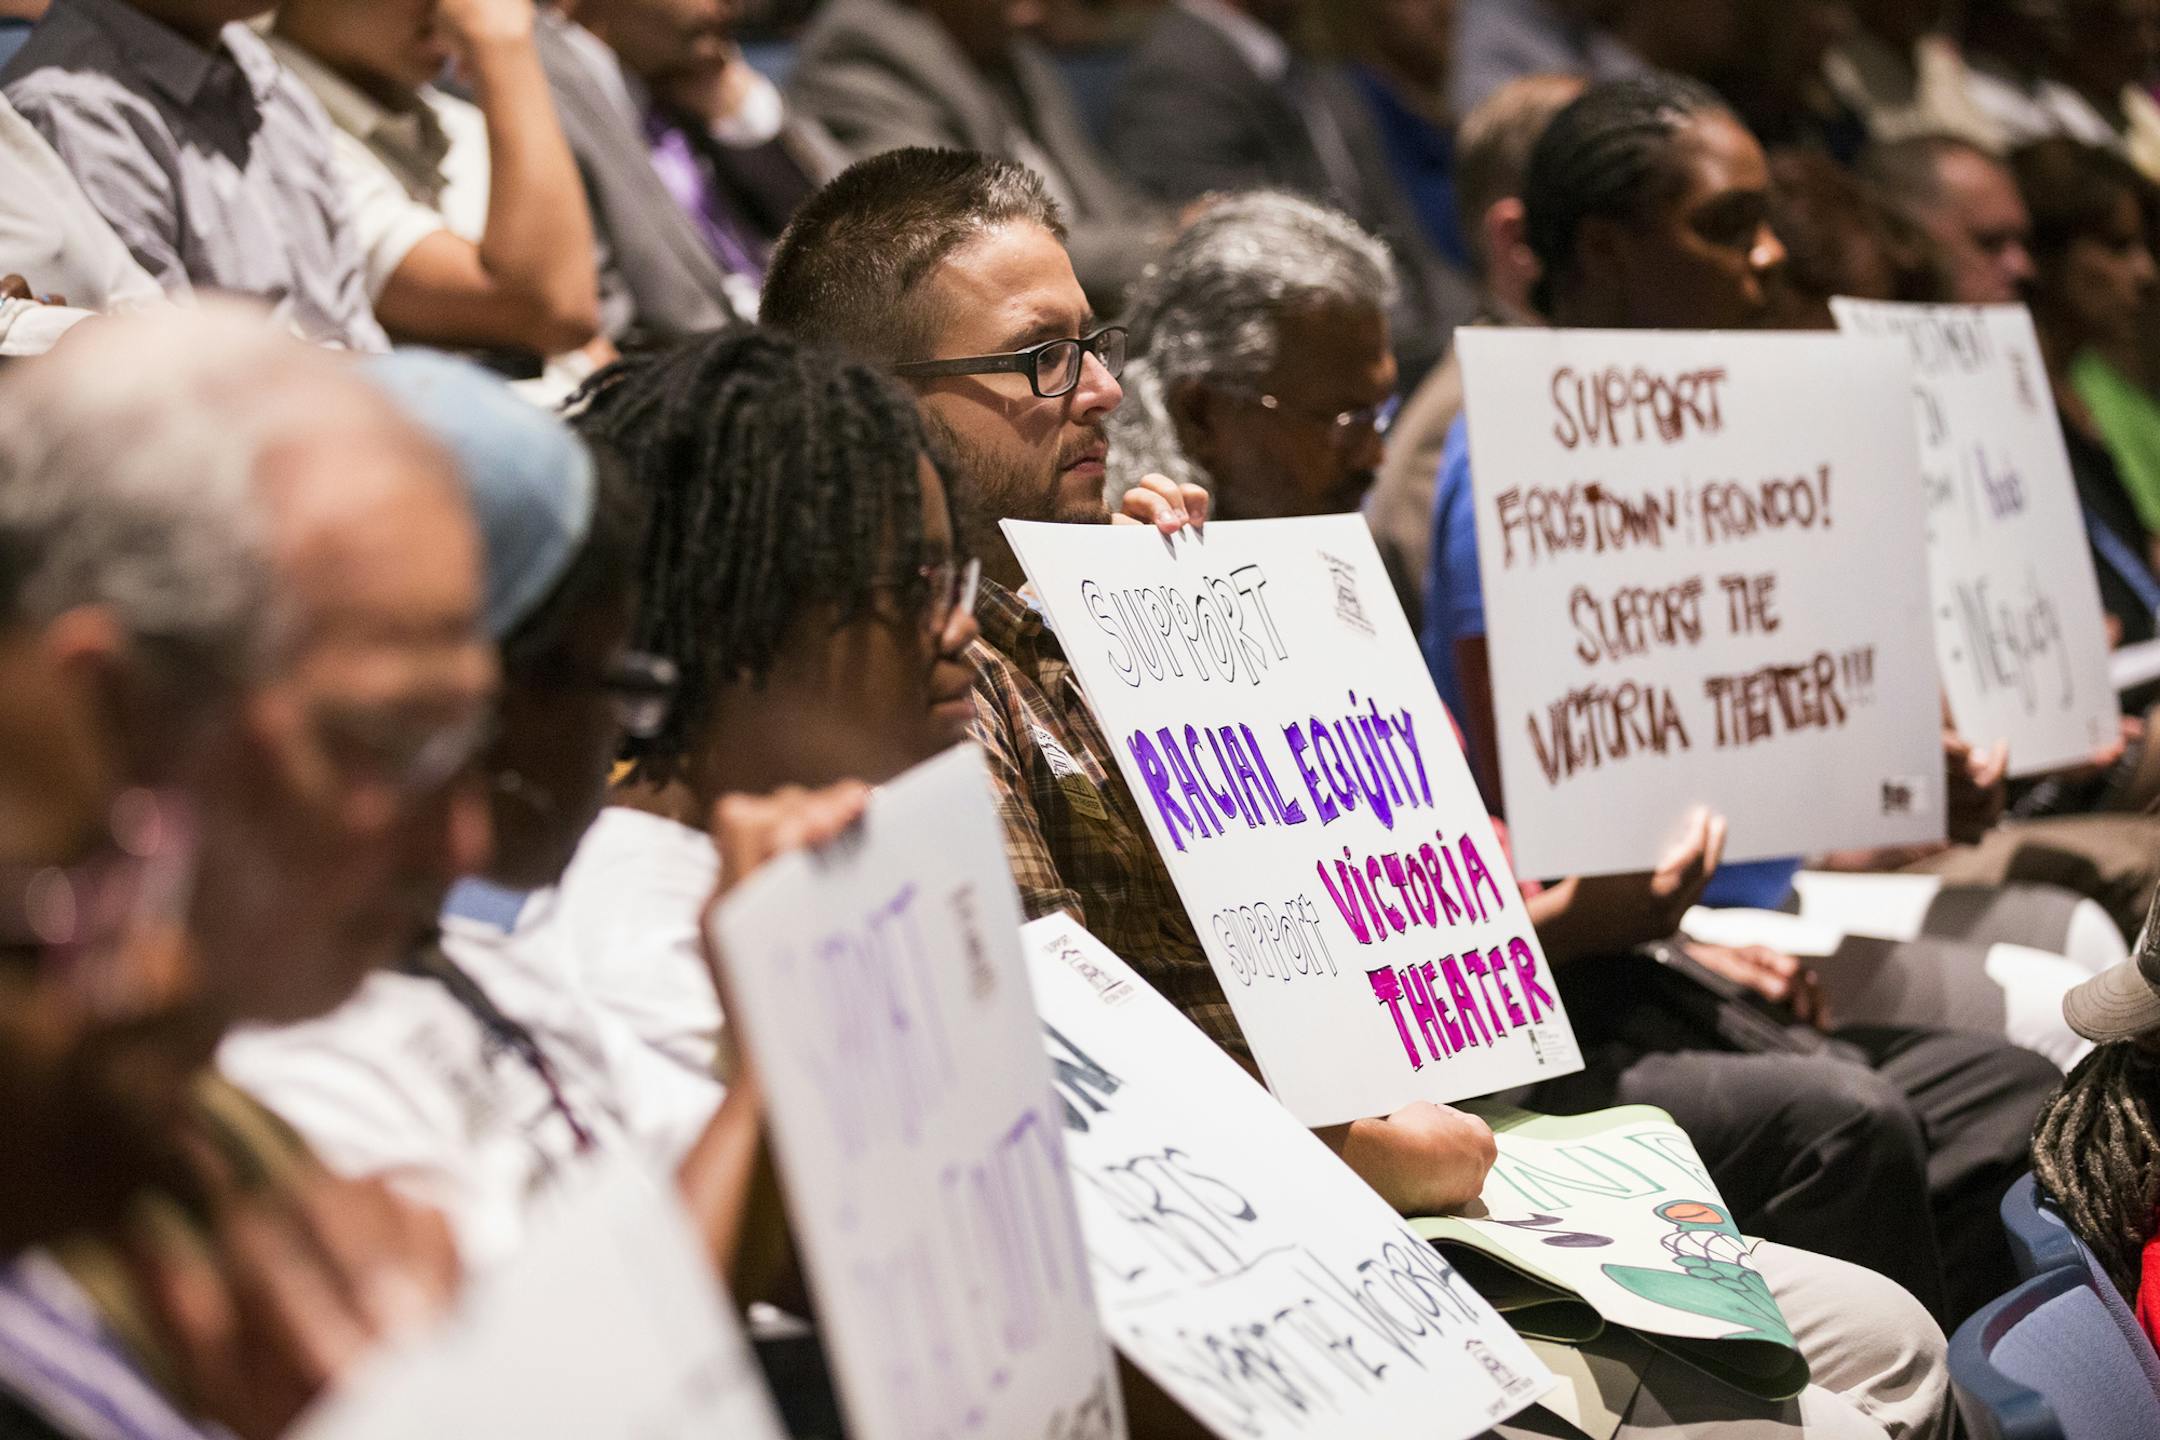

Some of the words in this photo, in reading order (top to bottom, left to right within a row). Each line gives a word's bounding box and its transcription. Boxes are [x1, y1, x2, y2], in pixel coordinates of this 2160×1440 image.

[1551, 366, 1727, 450] SUPPORT
[1495, 481, 1677, 569] FROGTOWN
[1700, 463, 1833, 545] RONDO!
[1081, 563, 1289, 688] SUPPORT
[1568, 574, 1703, 666] SUPPORT
[1718, 571, 1781, 635] THE
[1126, 721, 1308, 853] RACIAL
[1280, 689, 1434, 832] EQUITY
[1527, 680, 1690, 787] VICTORIA
[1316, 829, 1505, 945] VICTORIA
[1364, 936, 1556, 1072] THEATER
